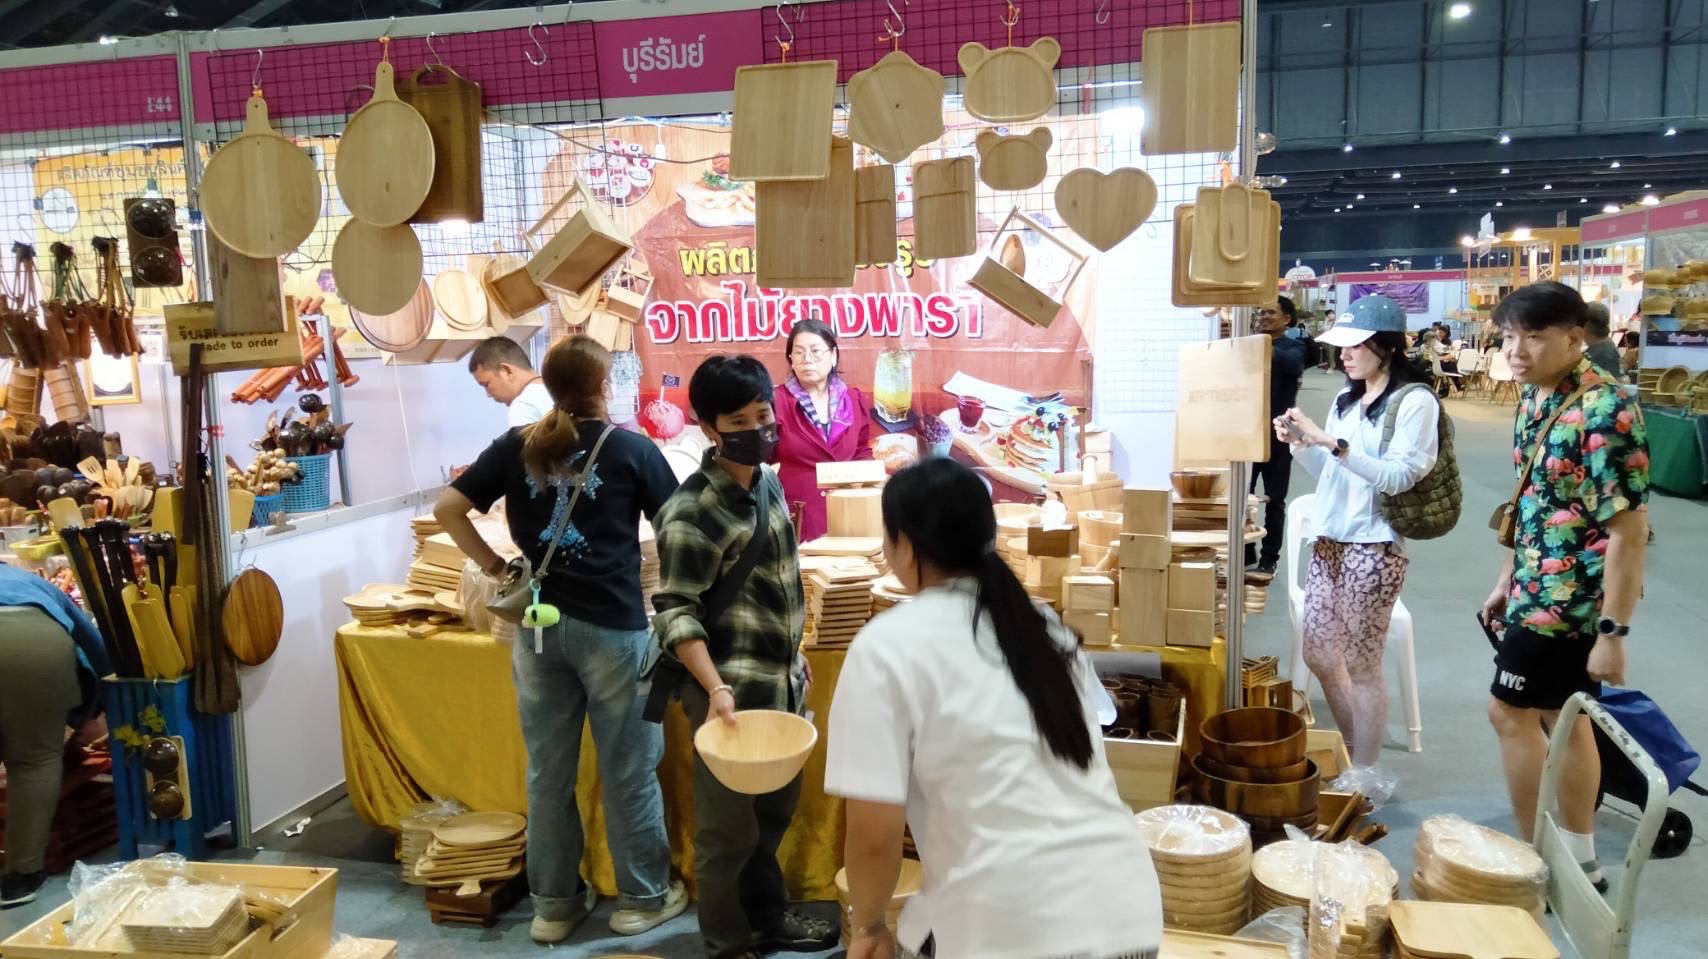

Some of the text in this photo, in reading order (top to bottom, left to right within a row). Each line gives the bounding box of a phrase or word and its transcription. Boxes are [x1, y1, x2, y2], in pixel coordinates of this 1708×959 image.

[623, 34, 705, 84] บุรีรัมย์
[645, 279, 985, 344] จากไม้ยางพารา
[231, 340, 243, 350] to
[248, 337, 279, 348] order
[1500, 670, 1526, 691] NYC
